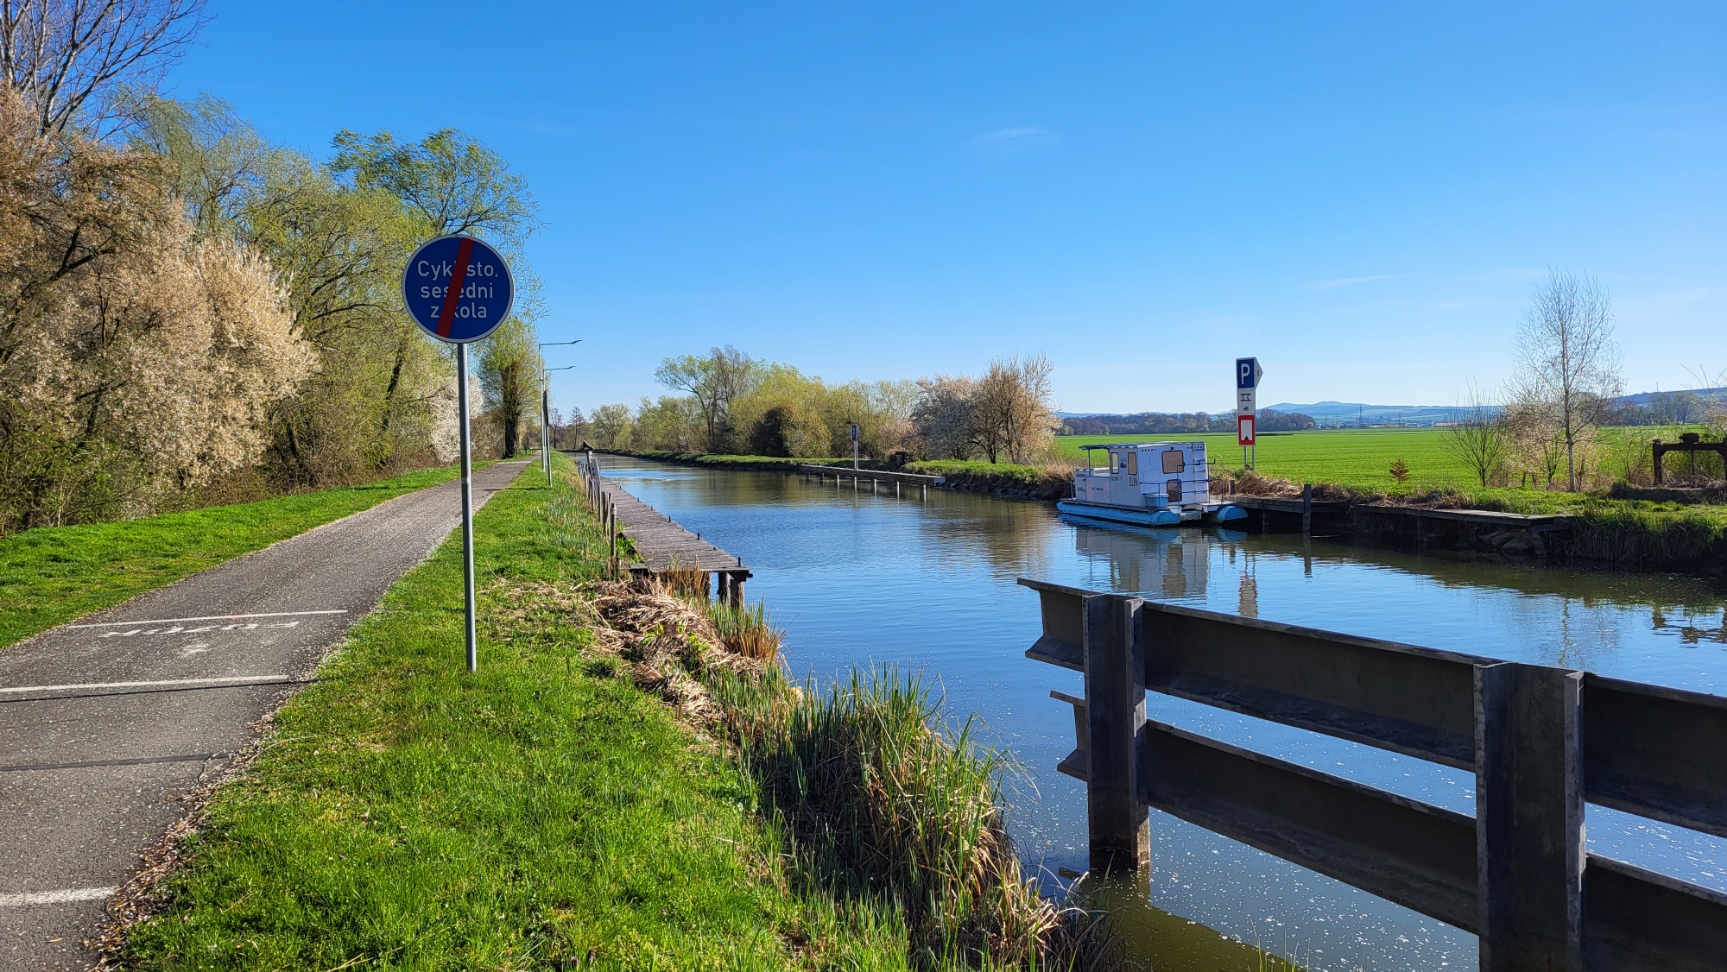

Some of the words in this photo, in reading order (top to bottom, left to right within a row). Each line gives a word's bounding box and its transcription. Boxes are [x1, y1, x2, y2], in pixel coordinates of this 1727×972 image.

[417, 260, 498, 281] Cyksto,
[430, 305, 440, 319] z
[1241, 363, 1251, 385] P
